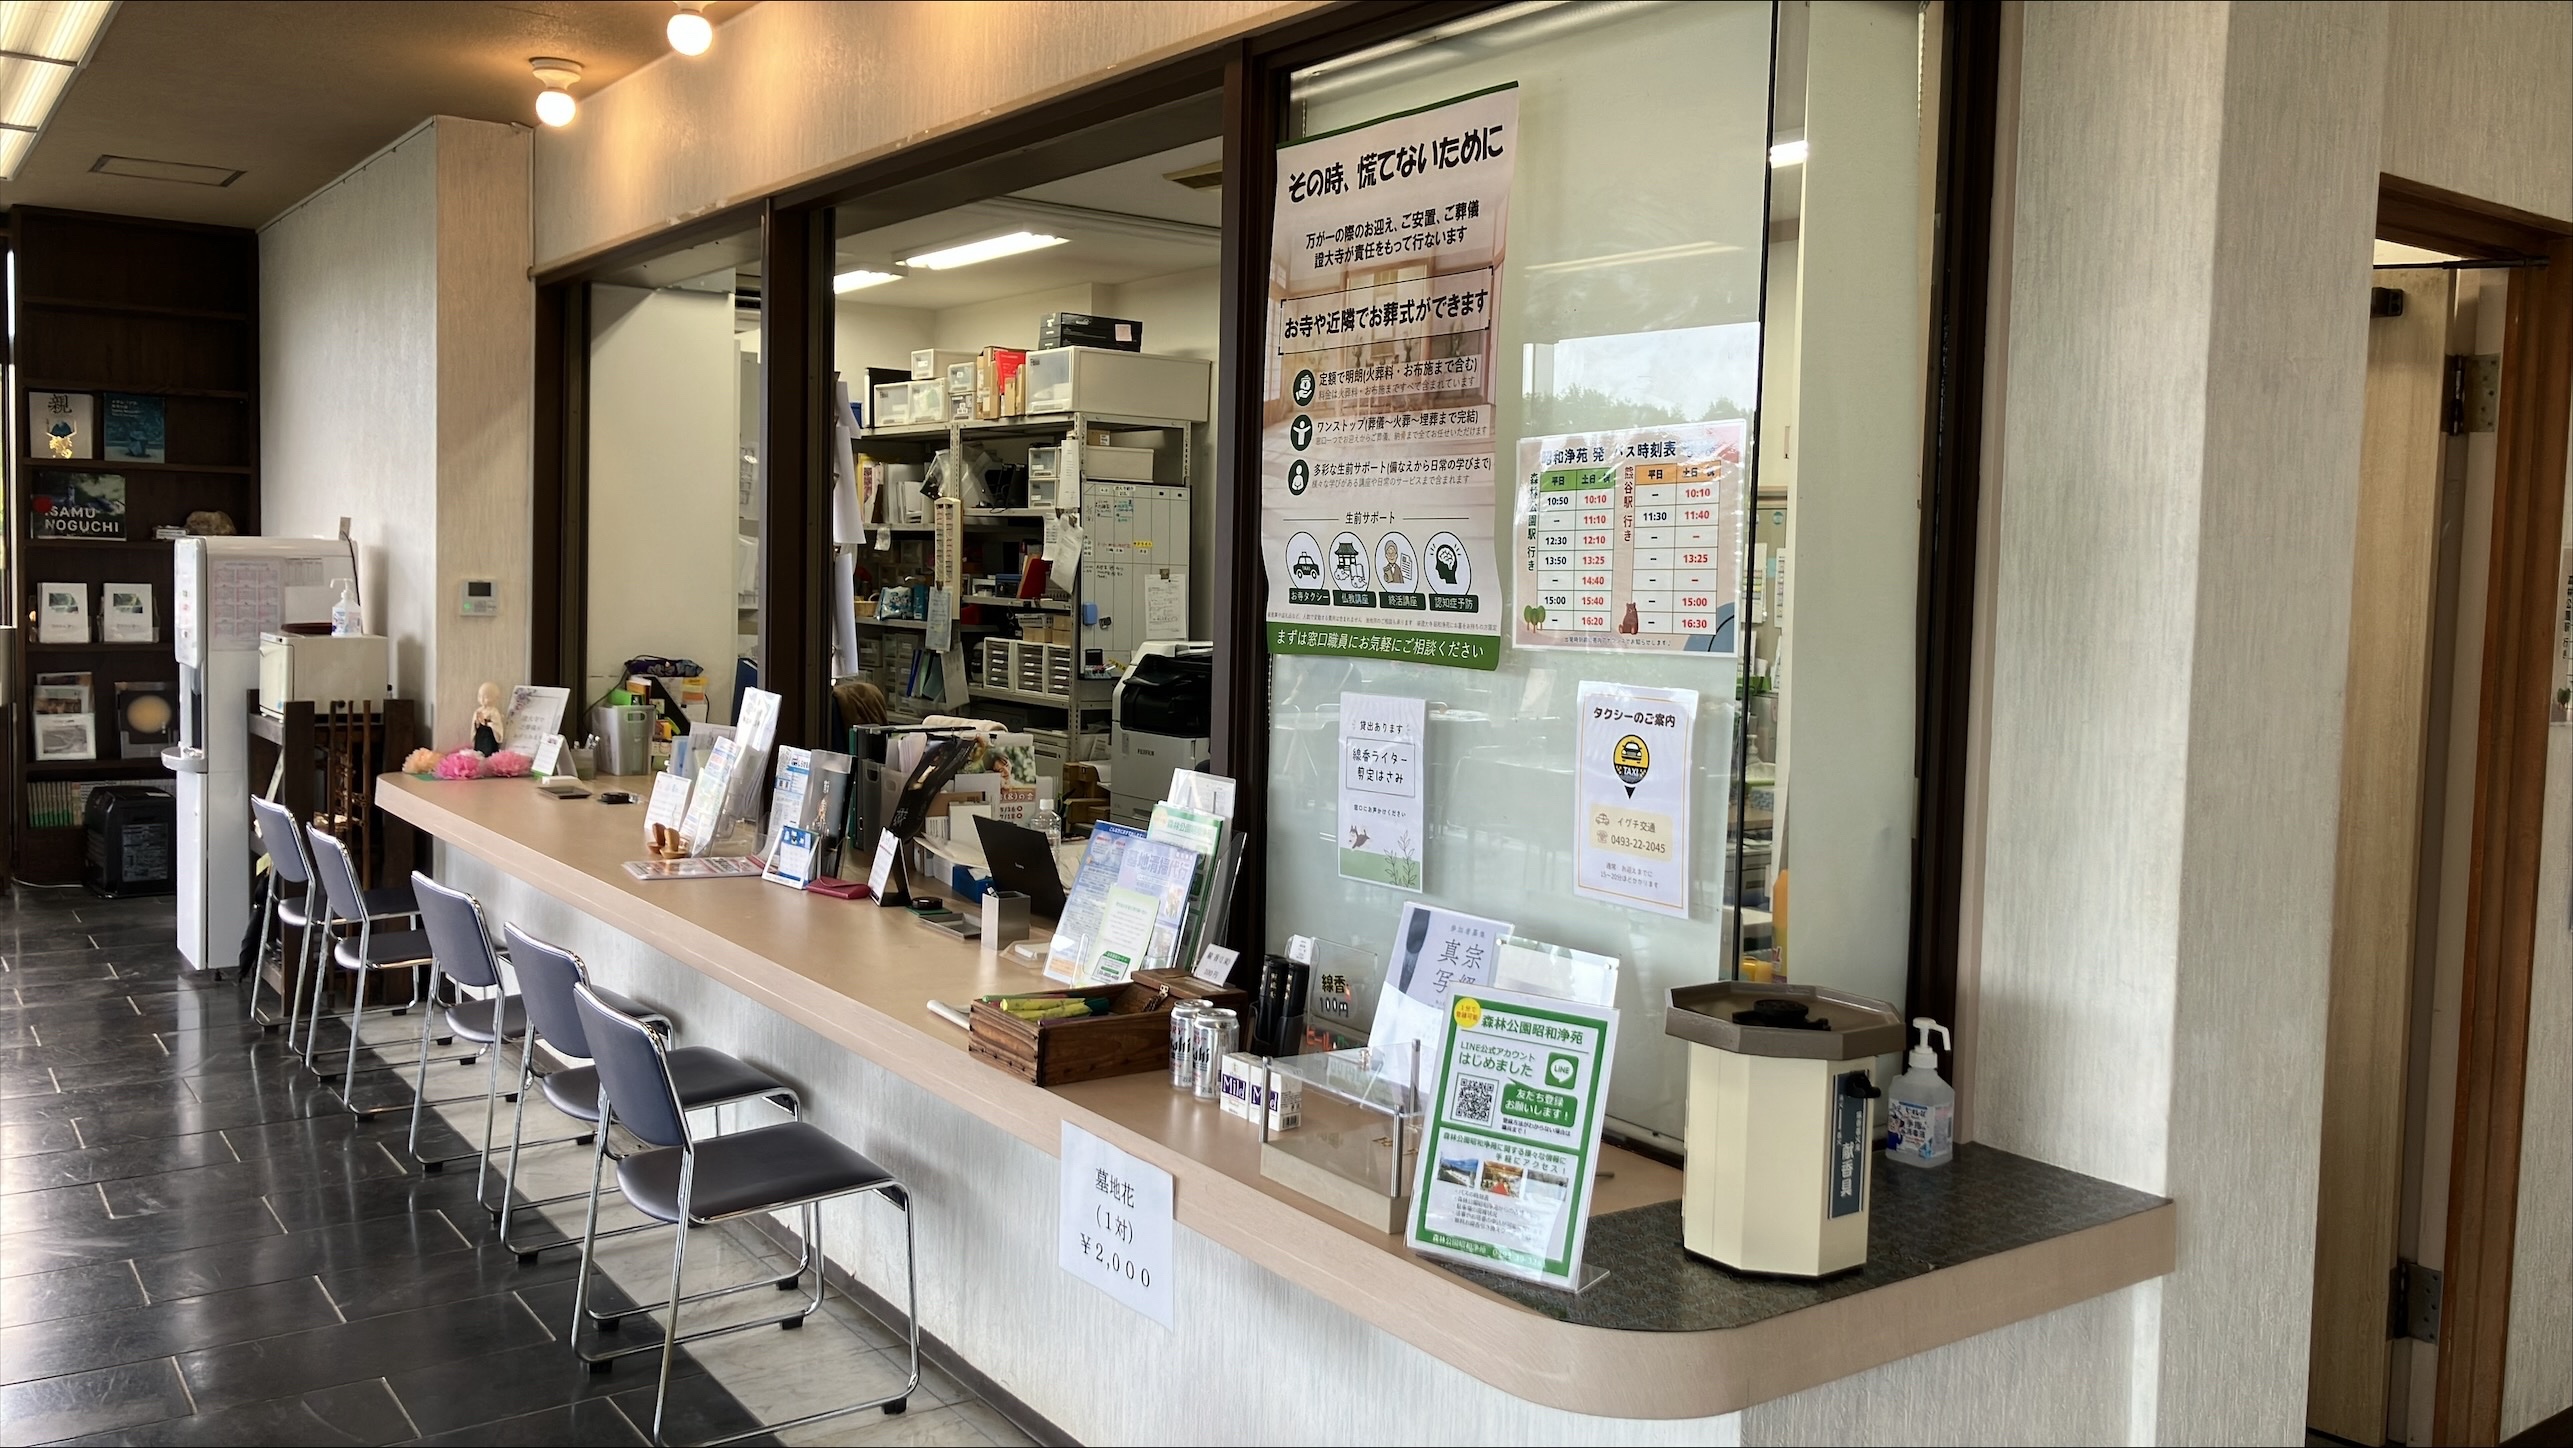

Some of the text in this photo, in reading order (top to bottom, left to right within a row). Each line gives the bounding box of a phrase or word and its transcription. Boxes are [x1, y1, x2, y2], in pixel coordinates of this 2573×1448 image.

[1288, 125, 1504, 203] その時、慌てないために
[1306, 200, 1479, 249] 万が一の際のお迎え、ご安置、ご葬儀
[1284, 288, 1489, 339] お寺や近隣でお葬式ができます
[1319, 357, 1478, 387] 定額で明朗(火葬料・お布施まで含む)
[48, 394, 72, 414] 親
[1593, 446, 1605, 462] 発
[1551, 476, 1565, 486] 平日
[1648, 469, 1664, 480] 平日
[1584, 495, 1607, 504] 10:10
[1685, 488, 1711, 498] 10:10
[1547, 496, 1569, 506] 10:50
[1623, 466, 1634, 542] 熊谷駅 行き
[1345, 511, 1396, 525] 生前サポート
[1583, 515, 1607, 525] 11:10
[1643, 512, 1667, 522] 11:30
[1684, 510, 1710, 520] 11:40
[44, 519, 119, 533] NOGUCHI
[1545, 536, 1567, 546] 12:30
[1583, 535, 1606, 545] 12:10
[1527, 545, 1535, 571] 行き
[1545, 556, 1567, 565] 13:50
[1582, 555, 1605, 565] 13:25
[1683, 553, 1708, 564] 13:25
[1582, 576, 1605, 585] 14:40
[1291, 591, 1329, 602] お寺タクシー
[1341, 593, 1369, 606] 仏教講座
[1388, 595, 1418, 608] 終活講座
[1434, 597, 1474, 610] 認知症予防
[1544, 596, 1566, 605] 15:00
[1582, 596, 1604, 606] 15:40
[1682, 597, 1708, 607] 15:00
[1581, 616, 1604, 626] 16:20
[1682, 618, 1707, 629] 16:30
[1276, 629, 1485, 659] まずは窓口職員にお気軽にご相談ください
[1593, 705, 1677, 728] タクシーのご案内
[1360, 720, 1404, 735] 貸出あります
[1352, 748, 1408, 765] 線香ライター
[1623, 766, 1640, 777] TAXI
[1616, 816, 1656, 834] イグチ交通
[1610, 833, 1667, 855] 0493-22-2045
[1437, 939, 1485, 970] 真宗
[1321, 974, 1346, 993] 線香
[1319, 996, 1349, 1018] 100円
[1482, 1013, 1584, 1045] 森林公園昭和浄苑
[1460, 1041, 1535, 1063] LINE公式アカウント
[1459, 1054, 1534, 1077] はじめました
[1553, 1064, 1571, 1075] LINE
[1222, 1075, 1246, 1101] Mild
[1516, 1088, 1564, 1107] 友だち登録
[1504, 1099, 1569, 1121] お願いします！
[1095, 1166, 1135, 1209] 墓地花
[1432, 1234, 1487, 1254] 森林公園昭和浄苑
[1080, 1231, 1152, 1288] ¥2,000
